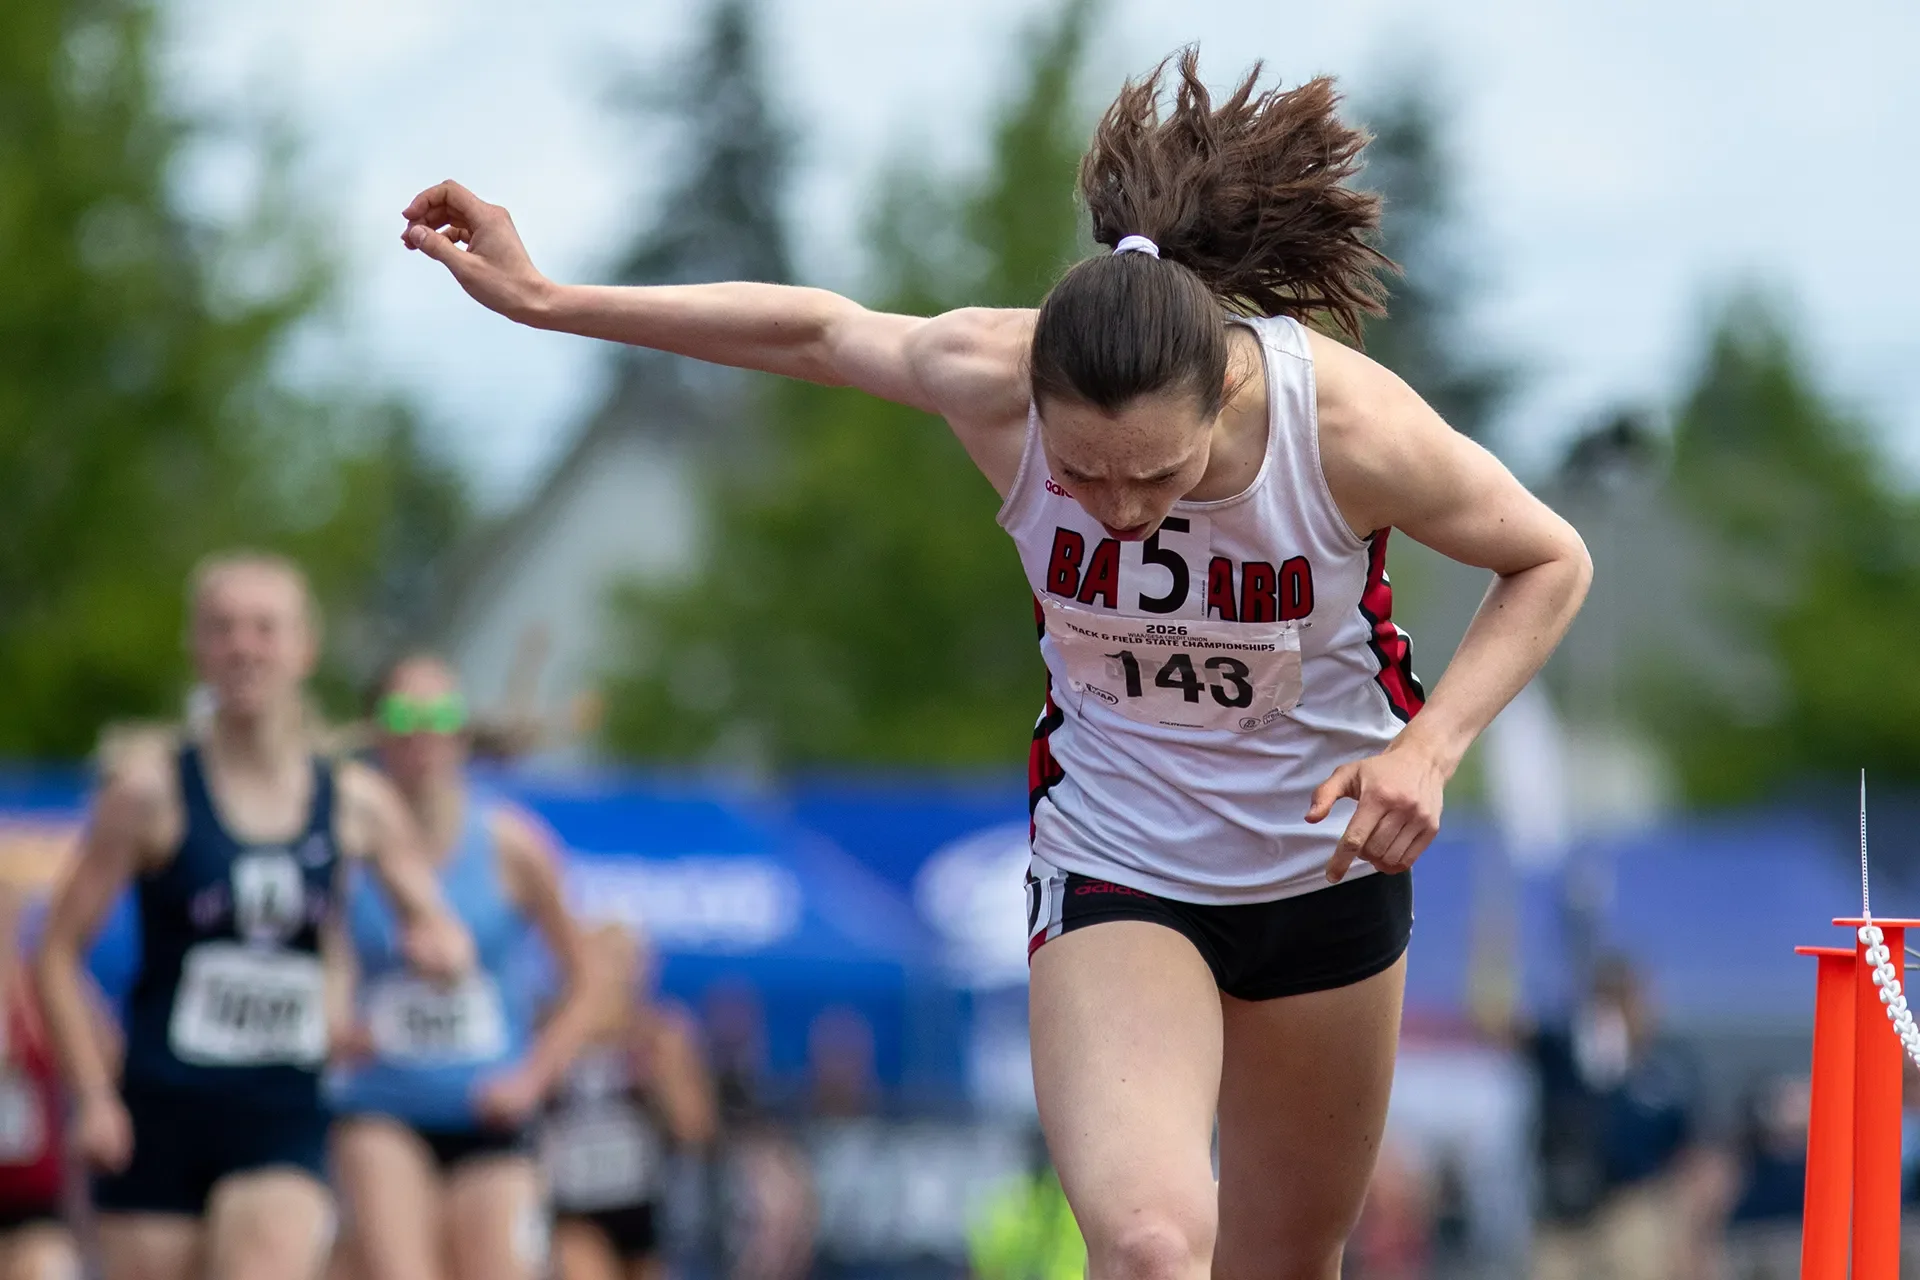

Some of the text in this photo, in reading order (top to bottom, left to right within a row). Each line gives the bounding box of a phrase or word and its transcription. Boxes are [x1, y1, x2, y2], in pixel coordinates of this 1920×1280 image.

[1139, 516, 1190, 614] 5
[1065, 621, 1276, 652] TRACK & FIELD STATE CHAMPIONSHIPS
[1145, 624, 1188, 636] 2026
[1104, 650, 1253, 708] 143
